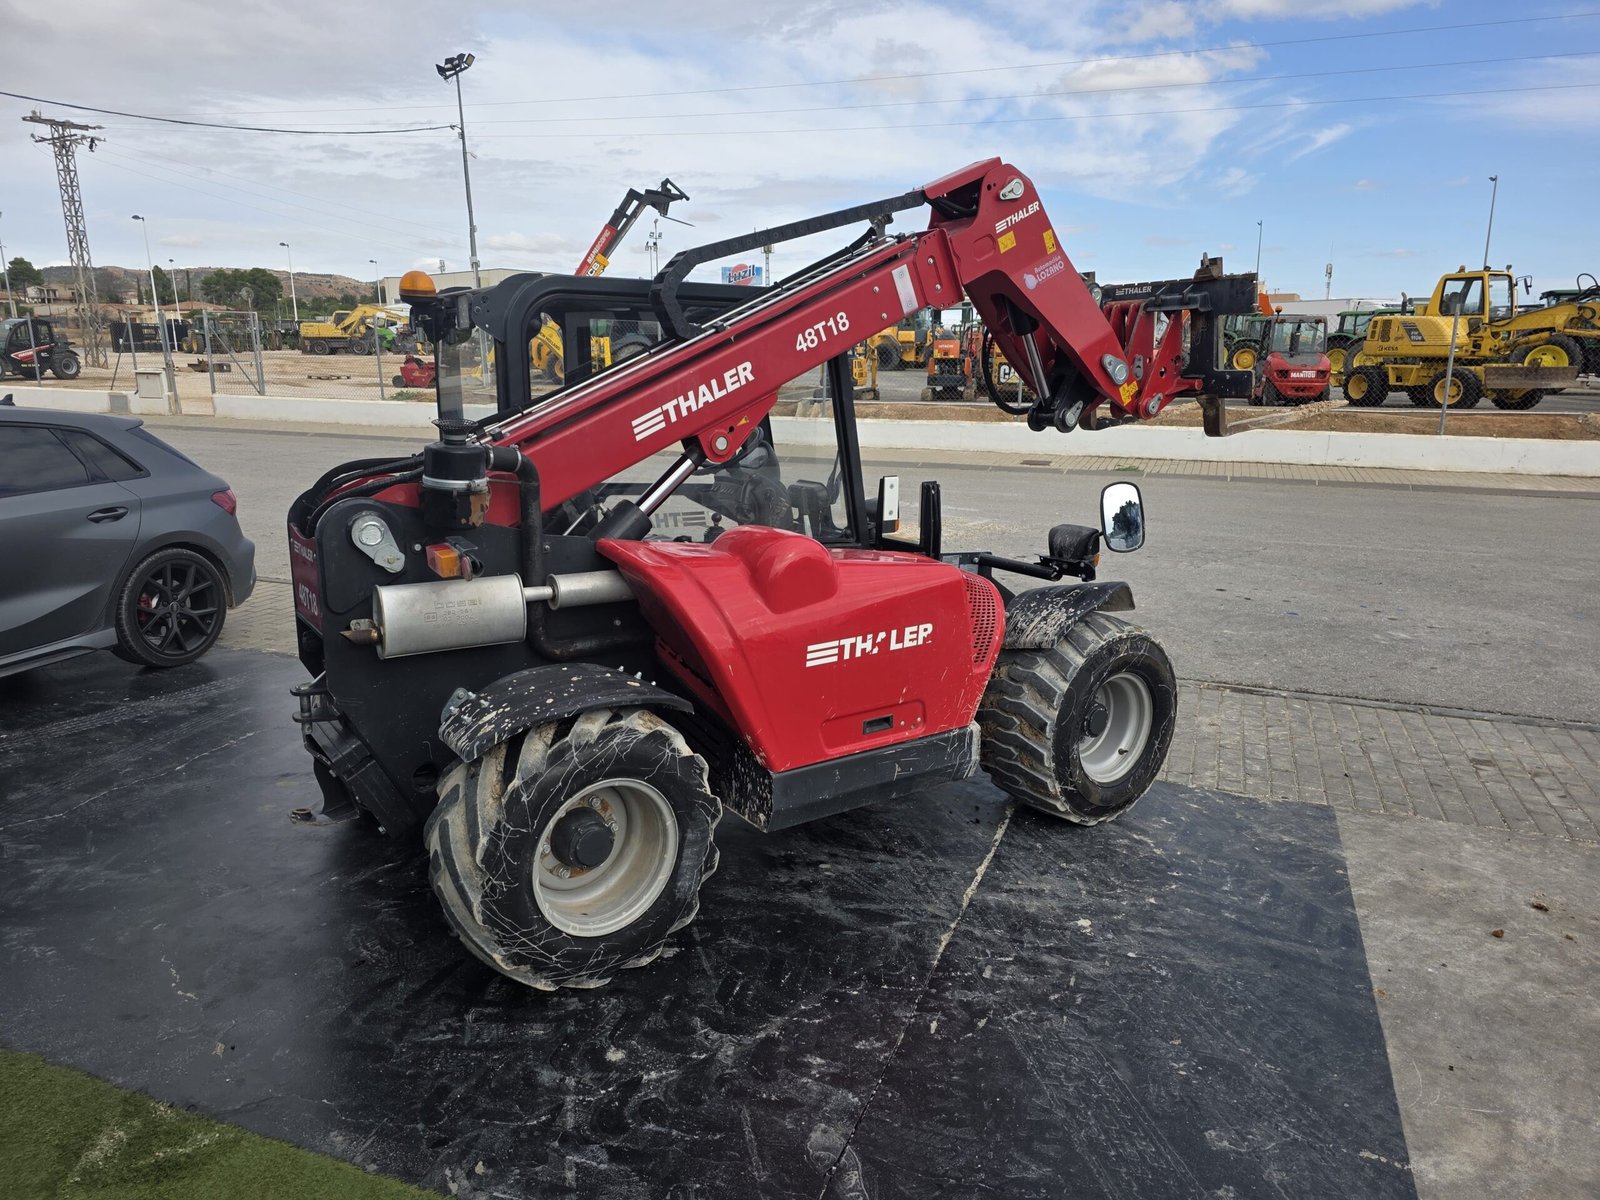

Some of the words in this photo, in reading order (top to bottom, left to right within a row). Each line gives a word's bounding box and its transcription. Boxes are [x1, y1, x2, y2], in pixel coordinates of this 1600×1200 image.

[1006, 201, 1040, 227] THALER
[587, 229, 611, 264] MANISCOPIC
[586, 262, 600, 276] CB
[1036, 261, 1065, 282] LOZANO
[1124, 285, 1153, 295] THALER
[796, 311, 850, 352] 48T18
[1290, 370, 1316, 378] MANITOU
[662, 361, 755, 423] THALER
[299, 583, 318, 617] 48T18
